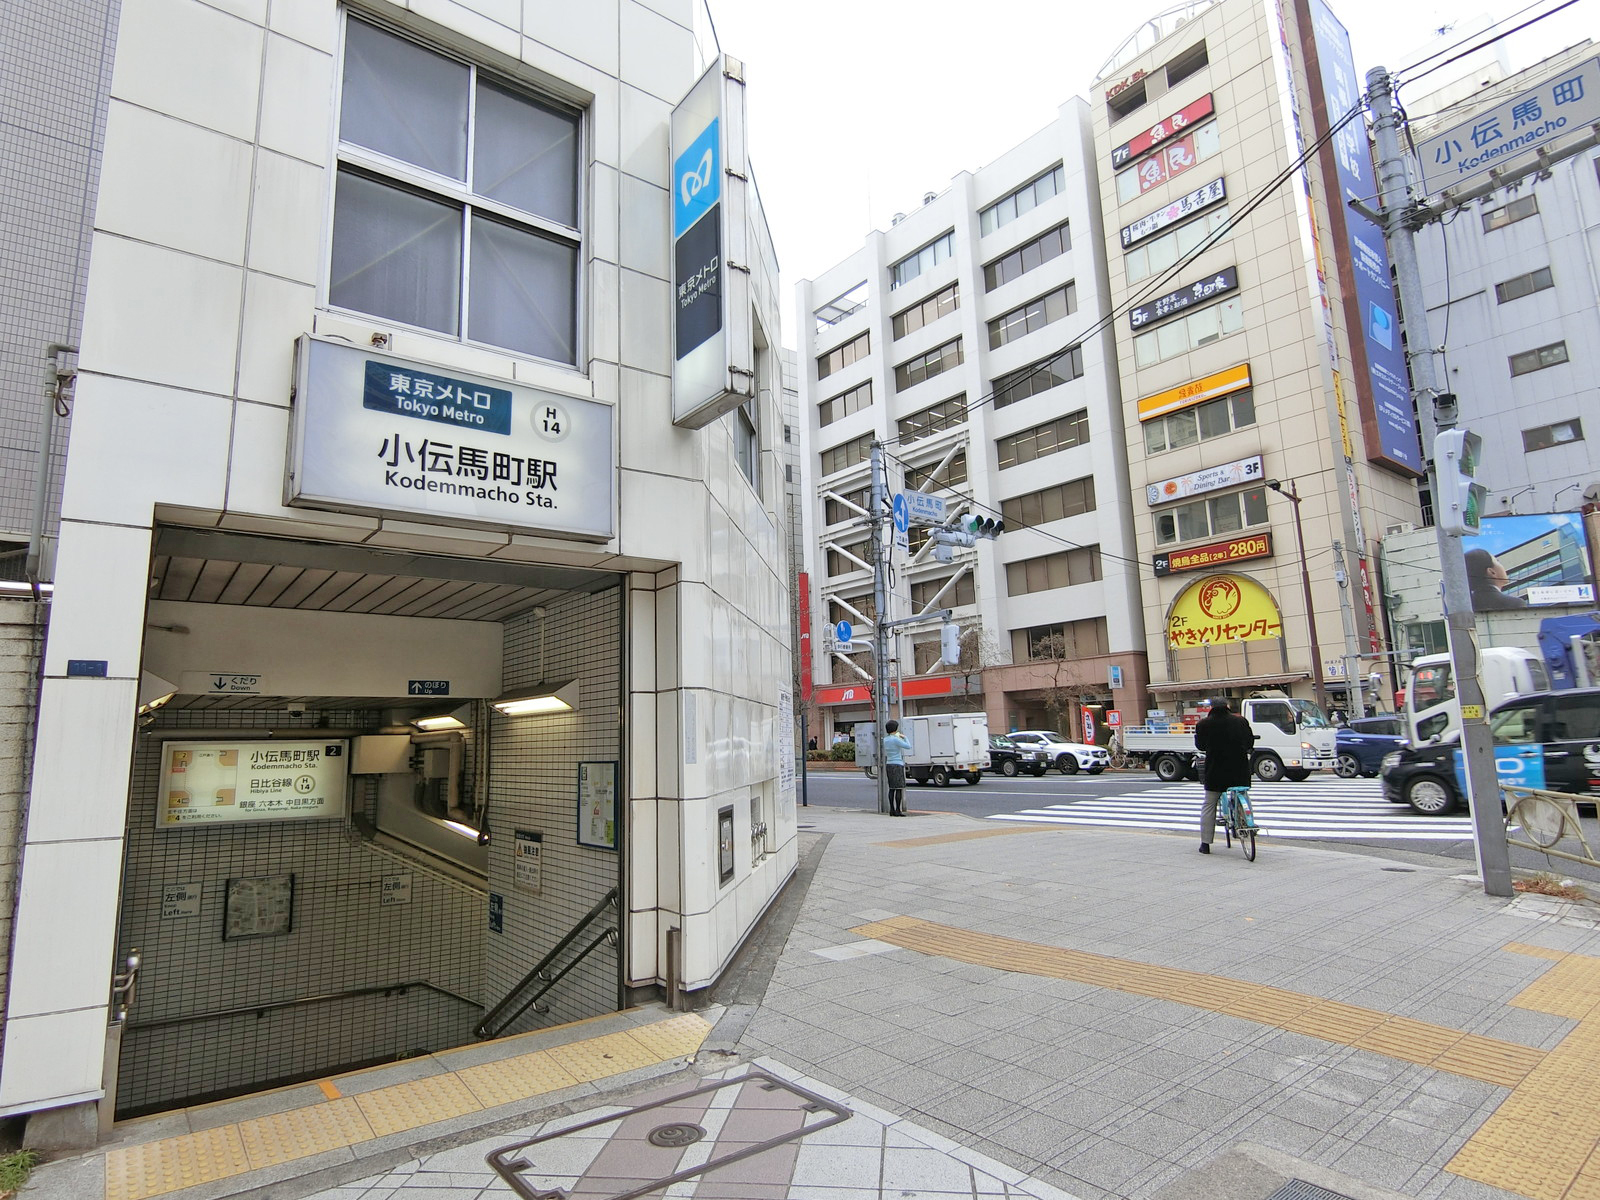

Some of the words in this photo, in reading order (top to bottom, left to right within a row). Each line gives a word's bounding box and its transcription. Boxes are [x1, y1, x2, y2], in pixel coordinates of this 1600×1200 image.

[1436, 75, 1584, 164] 小伝馬町
[1458, 116, 1567, 174] Kodenmacho
[1113, 148, 1129, 163] 7F
[678, 255, 718, 300] 東京メトロ
[681, 291, 698, 308] Tokyo
[698, 276, 716, 295] Metro
[1132, 309, 1148, 326] 5F
[389, 373, 491, 410] 東京メトロ
[396, 396, 438, 416] Tokyo
[442, 406, 484, 425] Metro
[546, 407, 557, 420] H
[542, 420, 562, 434] 14
[377, 433, 558, 492] 小伝馬町駅
[1245, 462, 1259, 474] 3F
[384, 470, 520, 504] Kodemmacho
[526, 491, 558, 510] Sta.
[908, 496, 942, 511] 小伝馬町
[1229, 540, 1266, 558] 280円
[1155, 560, 1168, 570] 2F
[1172, 616, 1188, 628] 2F
[1170, 619, 1280, 646] やきとりセンター
[231, 676, 257, 686] くだり
[424, 682, 447, 690] のぼり
[842, 690, 854, 700] JTB
[250, 750, 320, 762] 小伝馬町駅
[330, 747, 337, 756] 2
[250, 778, 292, 788] 日比谷線
[240, 800, 256, 808] 銀座
[259, 800, 283, 808] 六本木
[286, 798, 324, 806] 中目黒方面
[164, 908, 180, 916] Left
